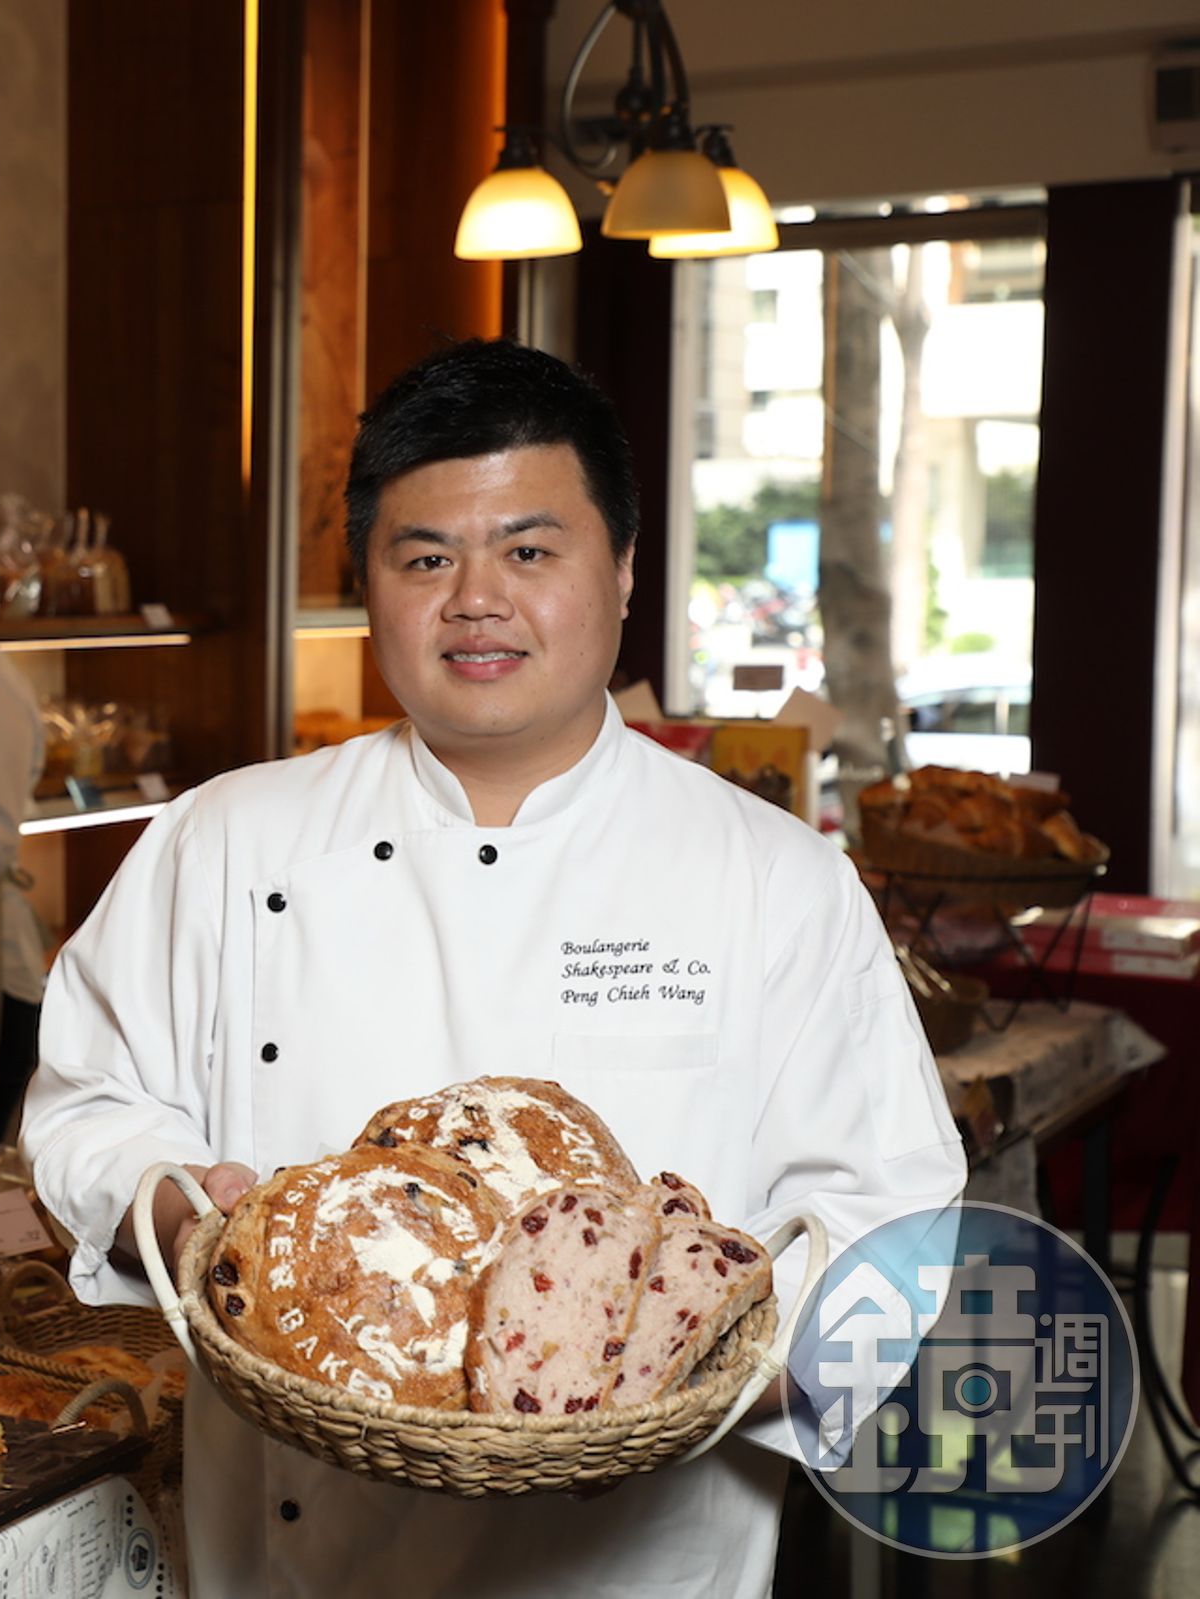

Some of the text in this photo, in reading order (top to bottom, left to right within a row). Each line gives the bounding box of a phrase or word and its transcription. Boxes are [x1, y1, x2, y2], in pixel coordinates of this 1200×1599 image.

[560, 938, 650, 957] Boulangerie
[561, 958, 712, 979] Shakespeare & Co.
[561, 984, 706, 1007] Peng Chieh Wang
